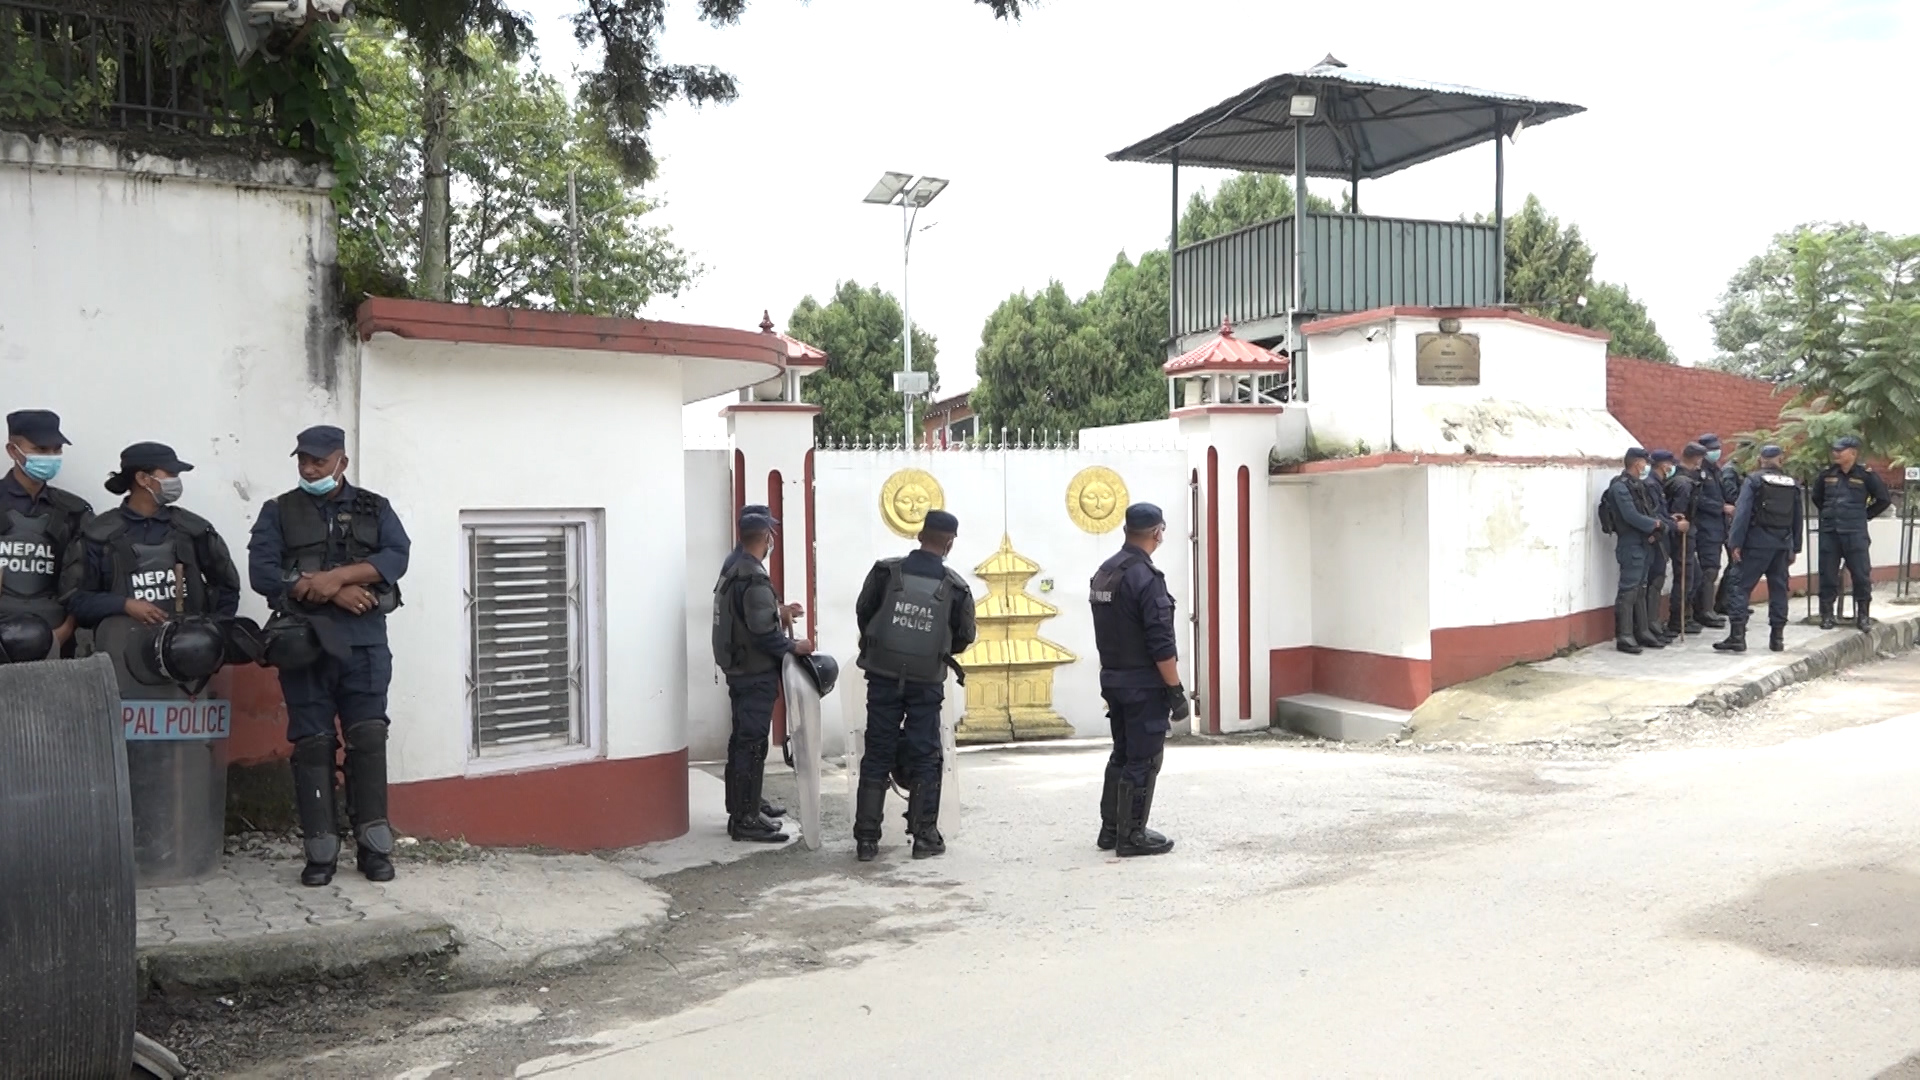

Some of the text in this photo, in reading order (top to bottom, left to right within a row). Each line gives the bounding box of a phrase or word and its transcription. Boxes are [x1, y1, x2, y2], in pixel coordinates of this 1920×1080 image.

[0, 541, 55, 559] NEPAL
[0, 557, 55, 574] POLICE
[131, 569, 186, 588] NEPA
[894, 601, 934, 620] NEPAL
[892, 614, 933, 632] POLICE
[166, 705, 226, 734] POLICE
